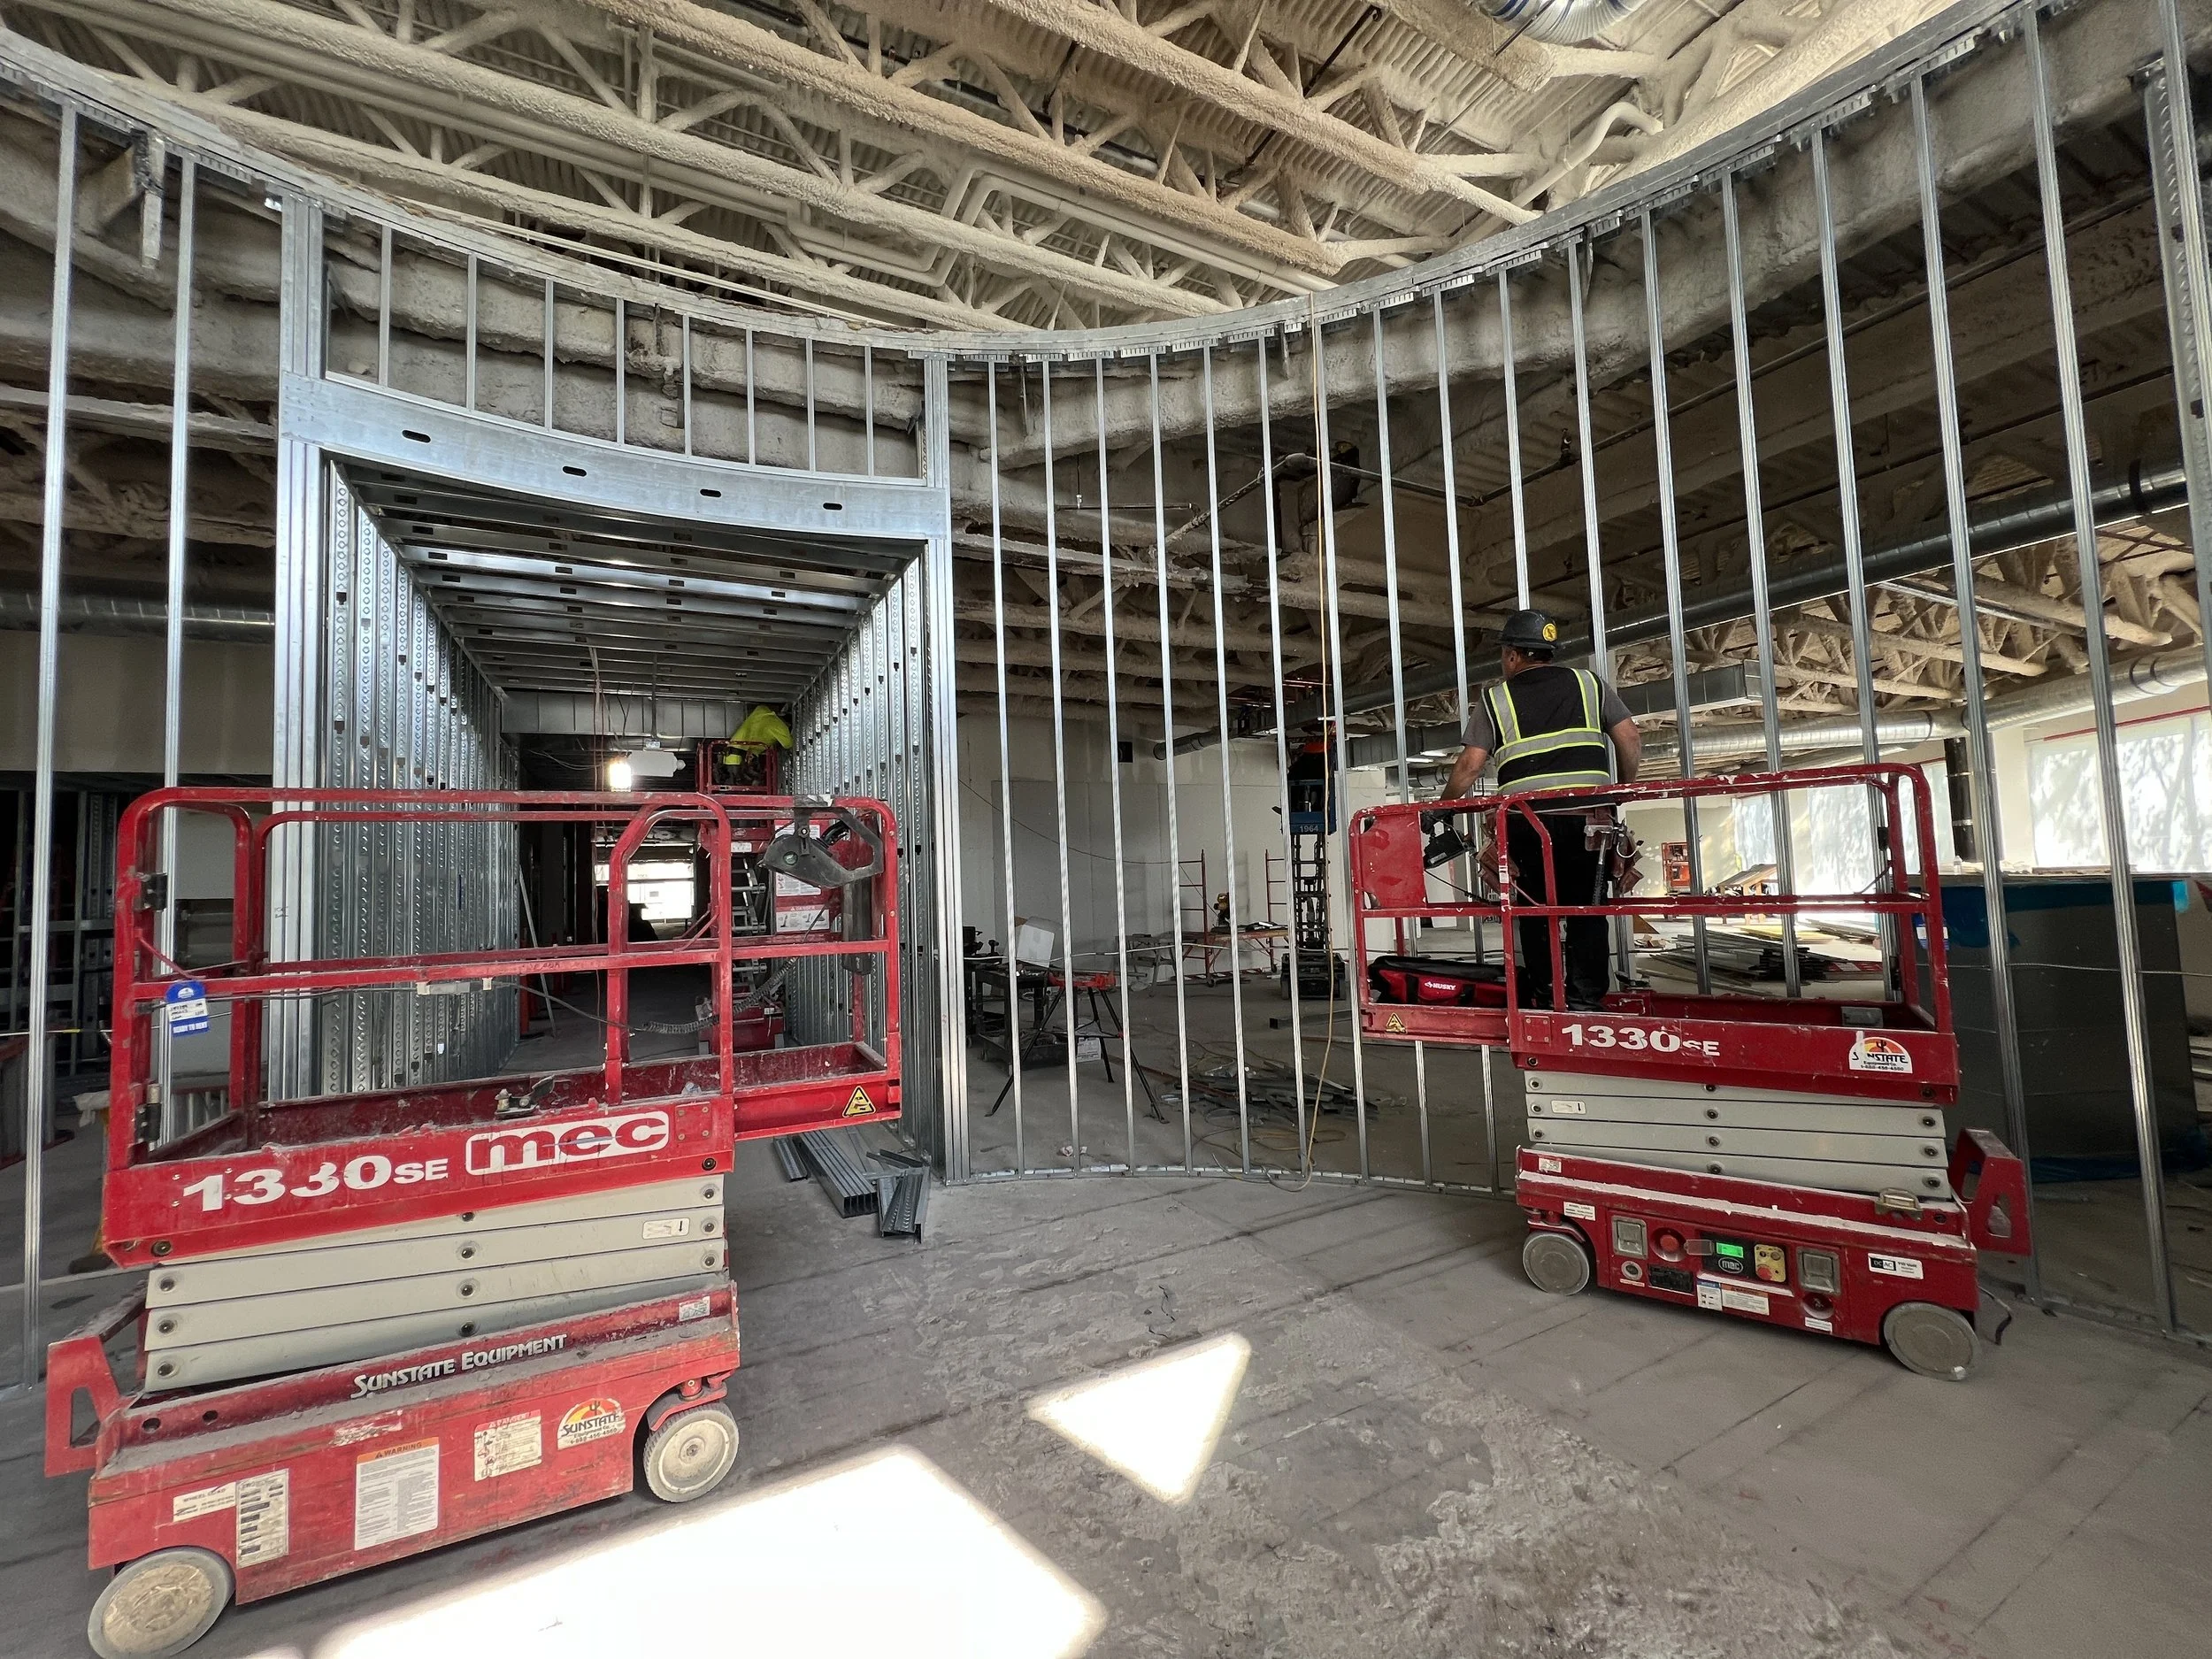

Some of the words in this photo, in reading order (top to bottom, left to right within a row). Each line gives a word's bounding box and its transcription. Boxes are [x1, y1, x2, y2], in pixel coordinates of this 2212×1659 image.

[470, 1118, 667, 1171] mec
[350, 1358, 456, 1399] SUNSTATE
[461, 1334, 568, 1371] EQUIPMENT
[561, 1413, 620, 1438] SUNSTATE
[384, 1441, 423, 1456] WARNING
